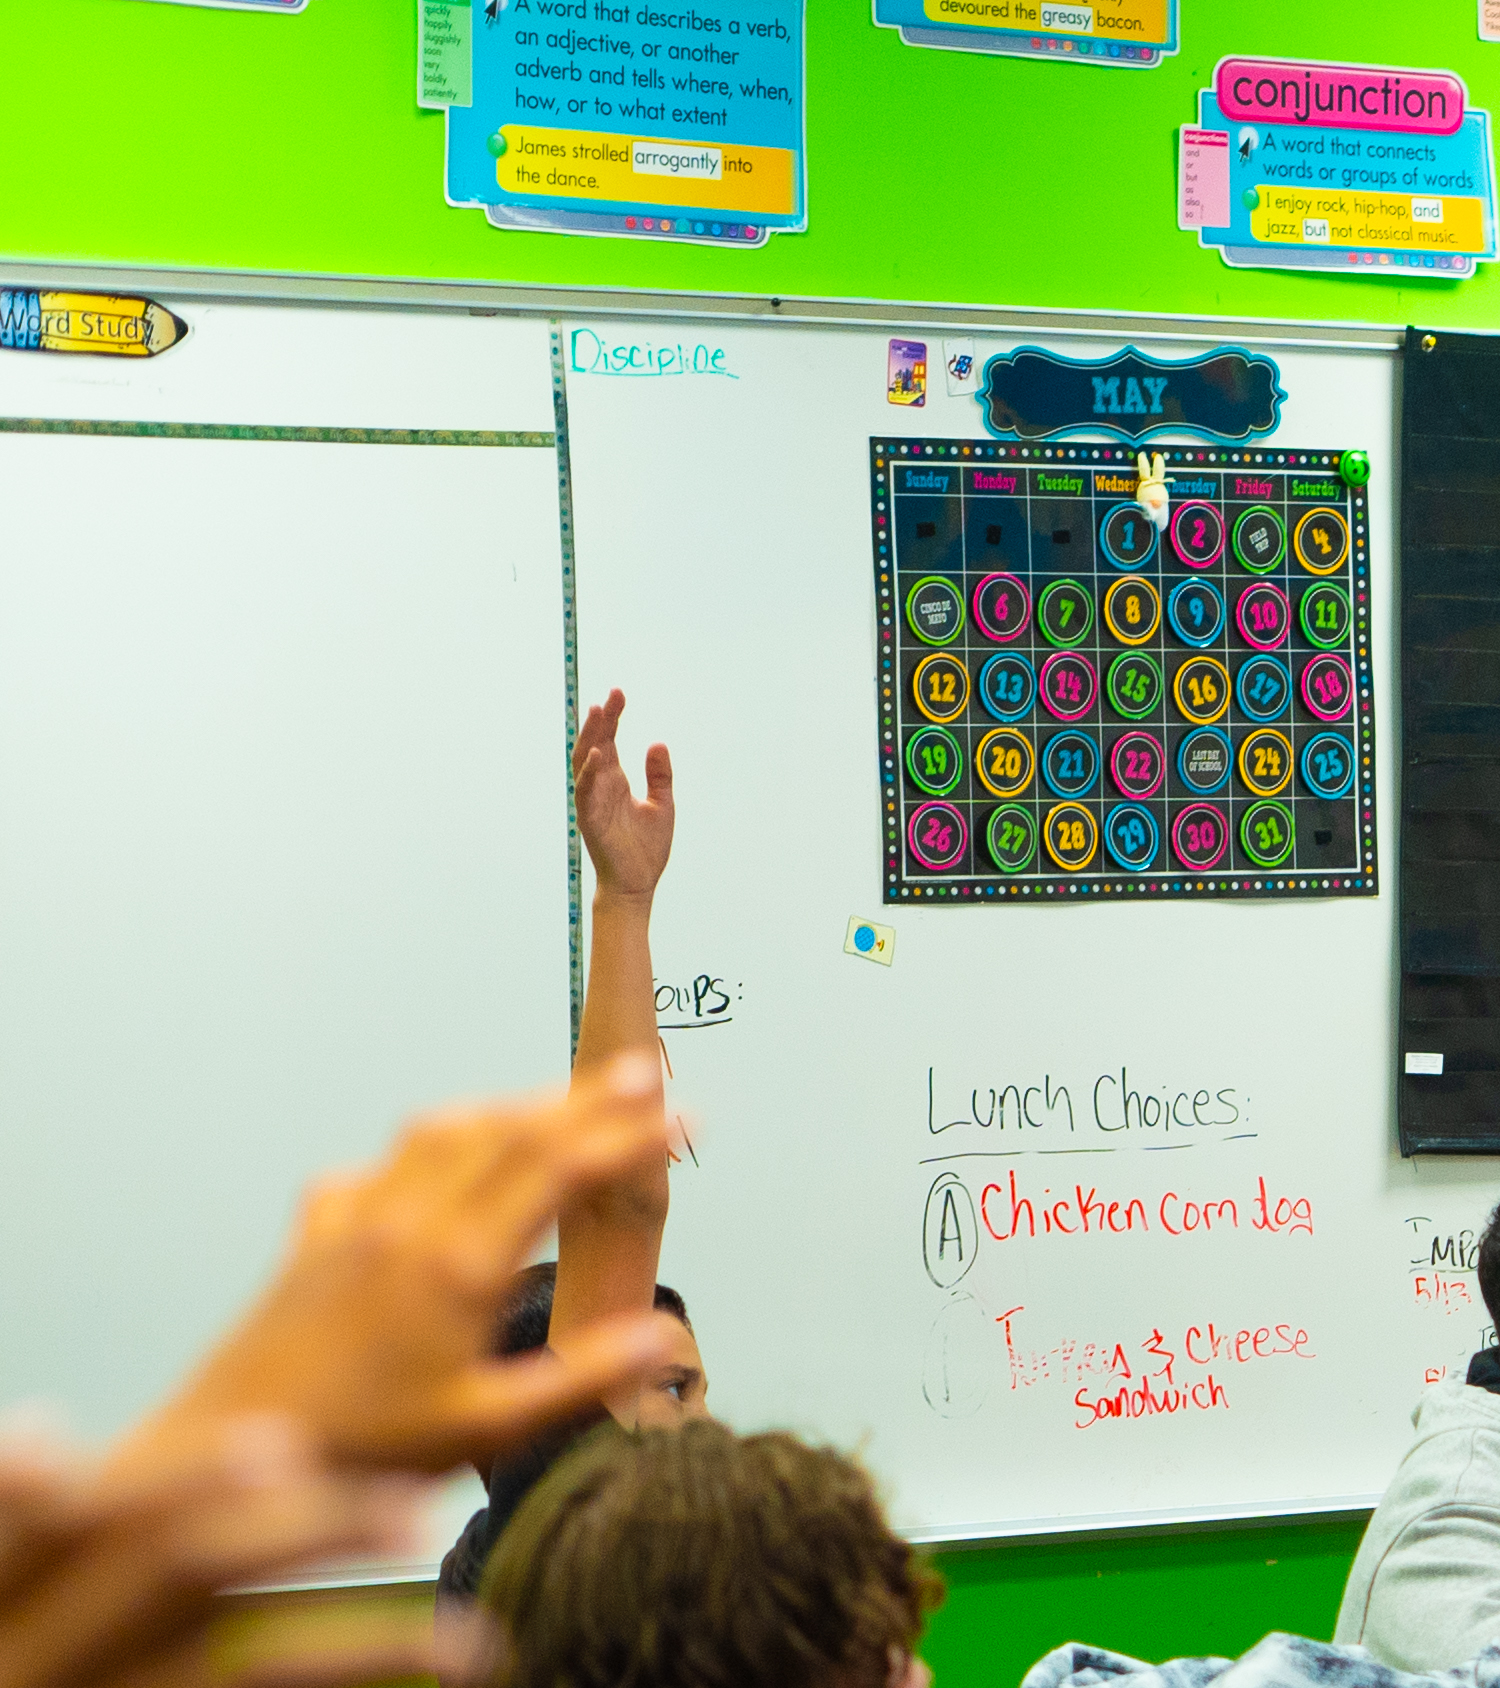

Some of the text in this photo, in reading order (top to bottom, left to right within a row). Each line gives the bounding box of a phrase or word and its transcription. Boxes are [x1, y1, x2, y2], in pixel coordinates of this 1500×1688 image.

[1042, 8, 1144, 31] greasy bacon.
[1234, 72, 1446, 122] conjunction
[516, 136, 752, 174] James strolled arrogantly into
[1263, 133, 1436, 162] A word that connects
[0, 308, 154, 345] Word Study
[1092, 376, 1167, 415] MAY
[906, 472, 1272, 497] Sunday Monday Tuesday Friday
[1250, 600, 1338, 629] 10 11
[929, 669, 1342, 701] 12 13 18
[991, 748, 1343, 779] 20 22 25
[1186, 821, 1215, 851] 30
[928, 1067, 1252, 1136] Lunch Choices:
[982, 1171, 1148, 1241] Chicken
[1250, 1176, 1315, 1236] dog
